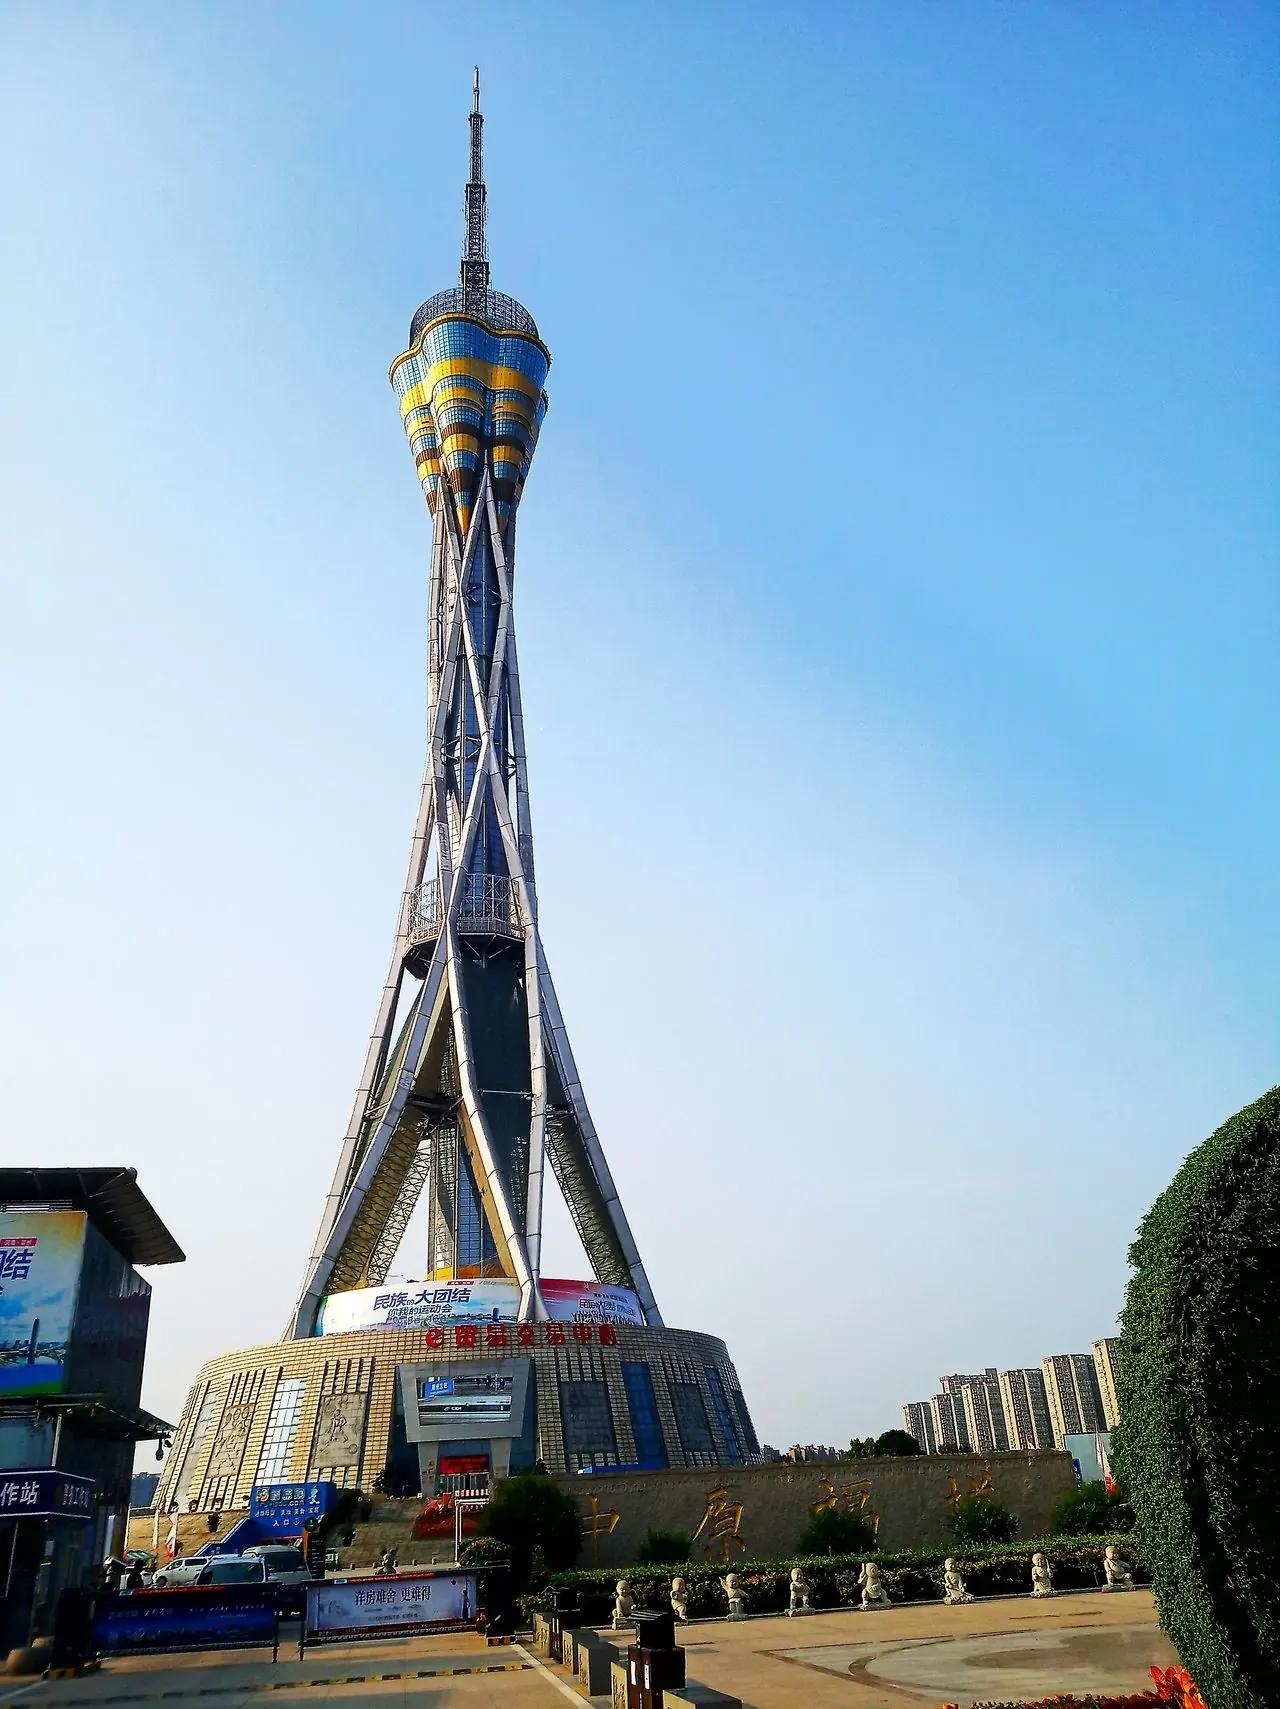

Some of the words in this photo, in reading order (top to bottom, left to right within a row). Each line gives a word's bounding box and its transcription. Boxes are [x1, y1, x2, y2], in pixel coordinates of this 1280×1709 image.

[0, 1249, 34, 1280] 结
[373, 1287, 472, 1311] 民族的大团结
[389, 1303, 453, 1316] 你我的运动会
[354, 1588, 397, 1606] 洋房难舍
[400, 1585, 432, 1604] 更难得
